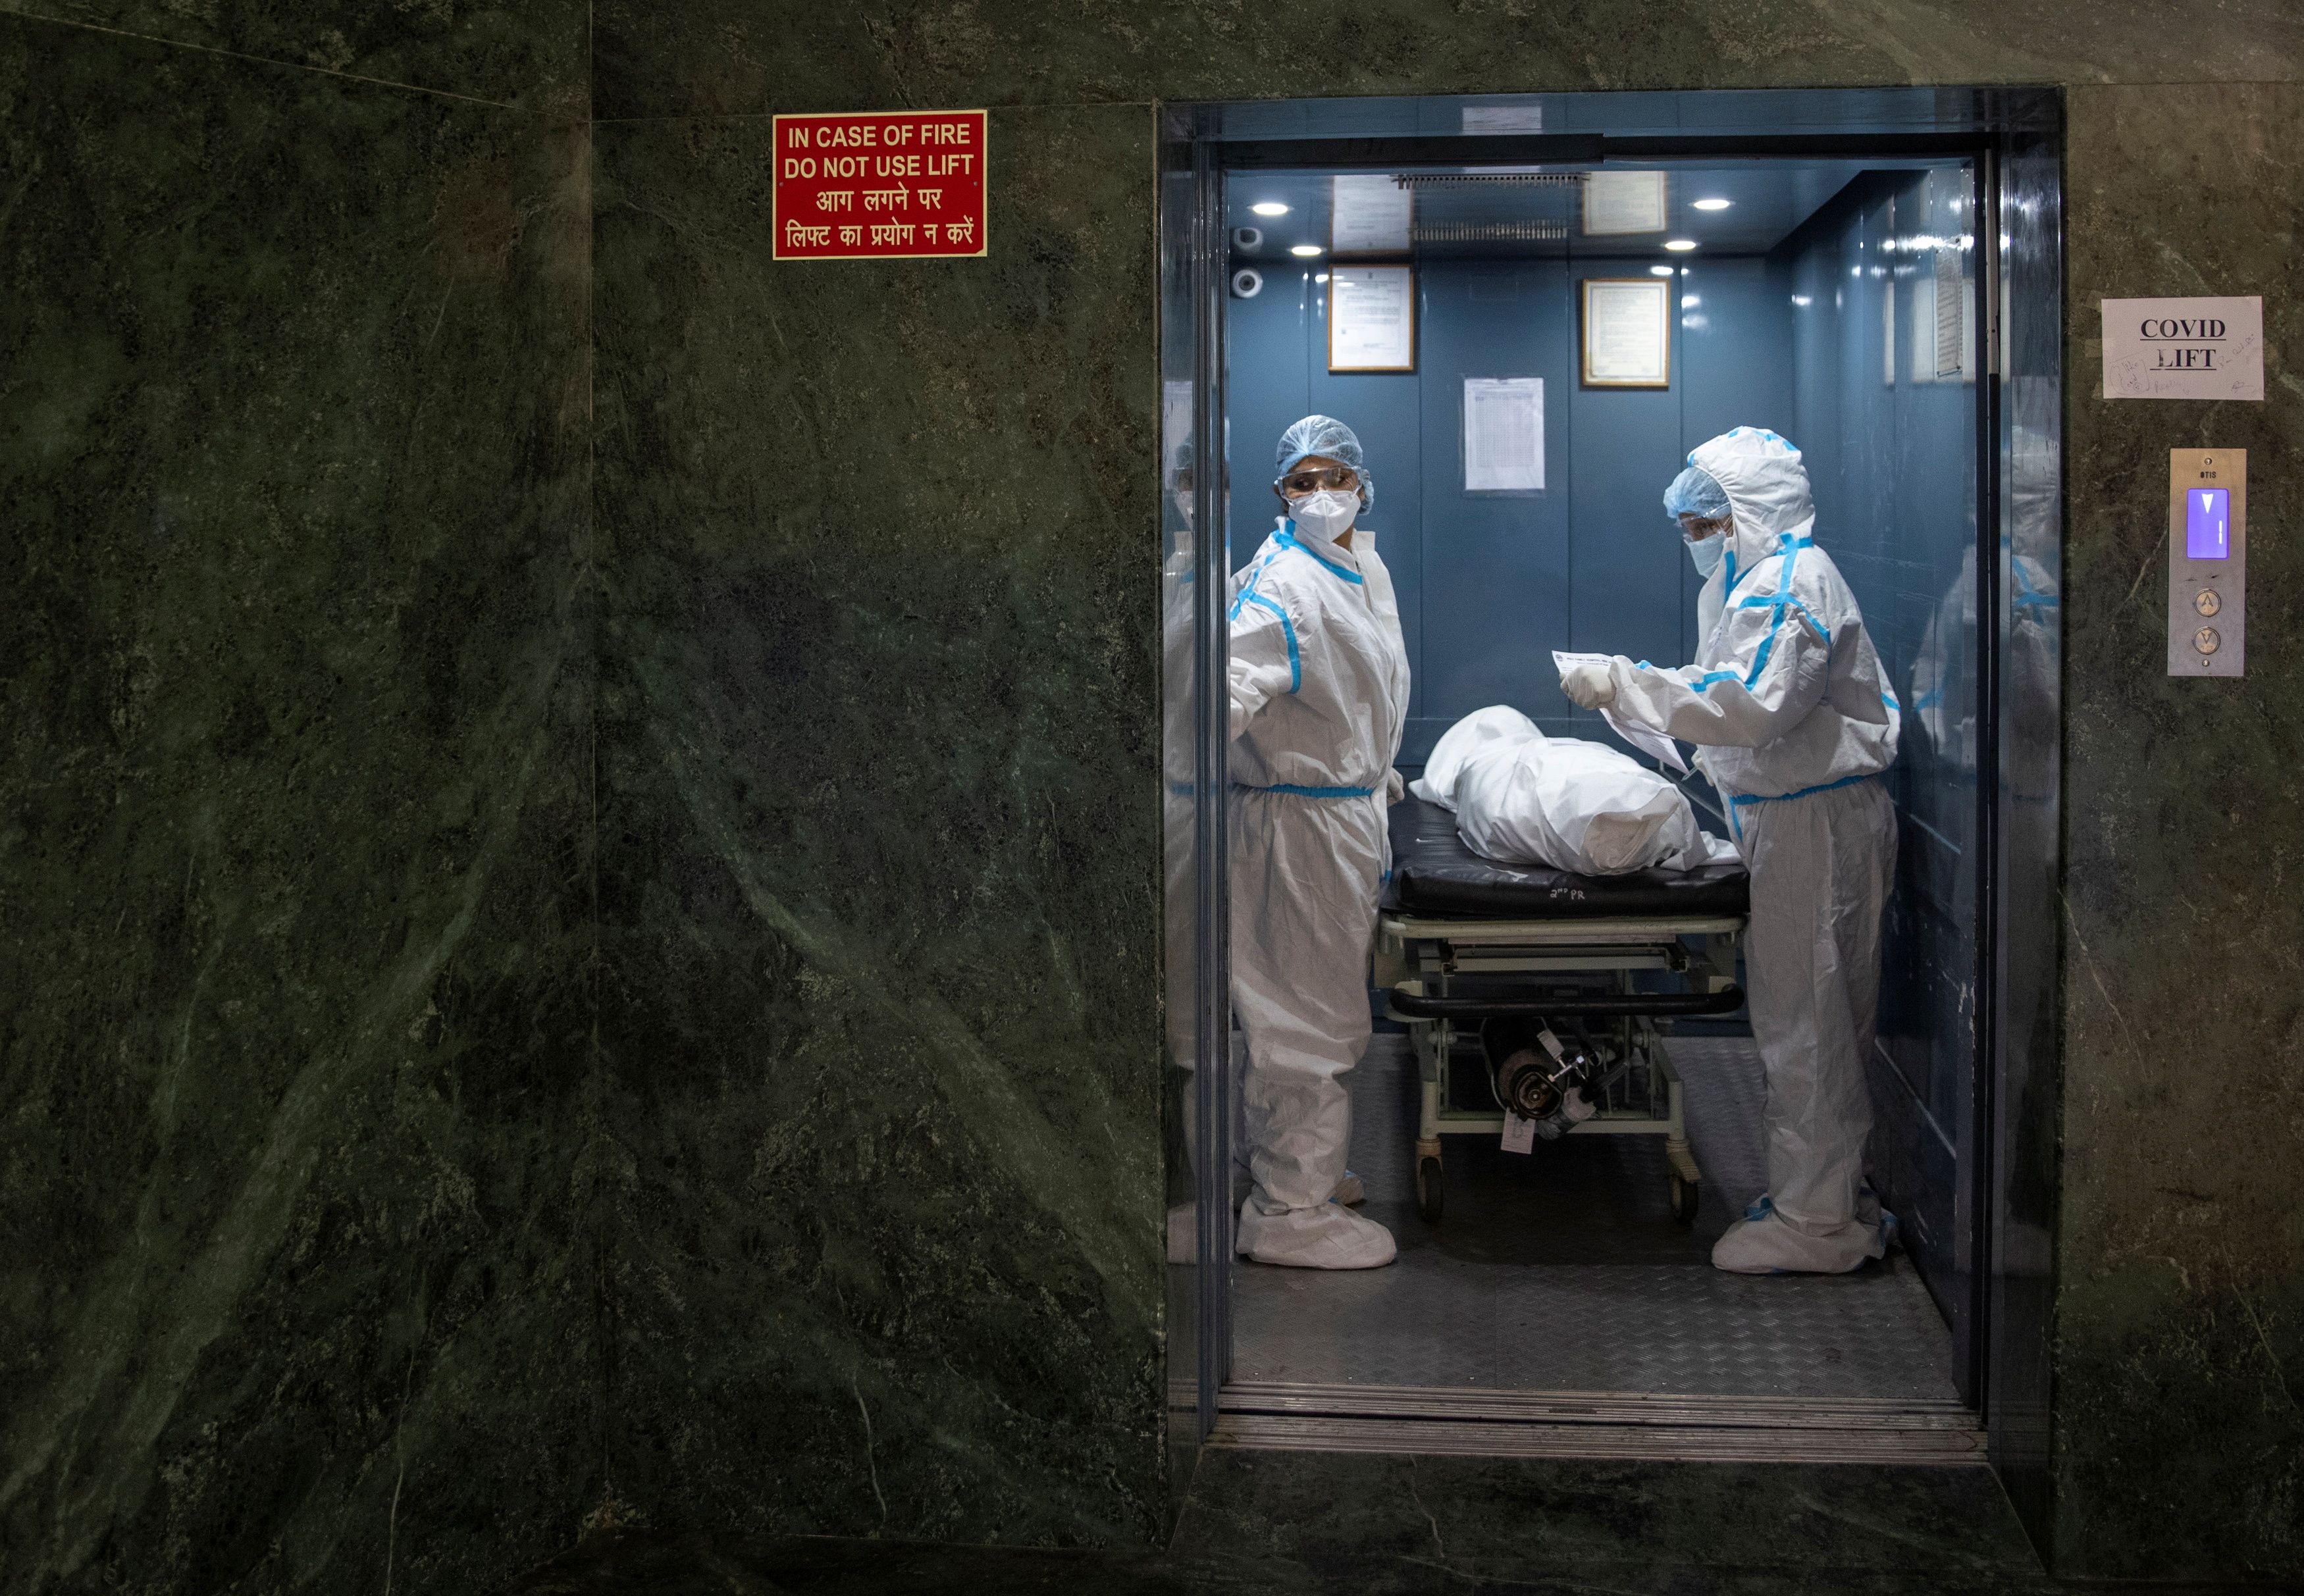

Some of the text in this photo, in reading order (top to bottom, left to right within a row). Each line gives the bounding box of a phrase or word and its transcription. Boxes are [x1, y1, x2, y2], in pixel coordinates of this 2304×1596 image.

[789, 123, 970, 148] IN CASE OF FIRE
[785, 154, 974, 178] DO NOT USE LIFT
[816, 181, 943, 212] आग लगने पर
[785, 215, 974, 247] लिफ्ट का प्रयोग न करें
[2141, 319, 2226, 338] COVID
[2157, 349, 2216, 367] LIFT
[1571, 889, 1585, 900] PR
